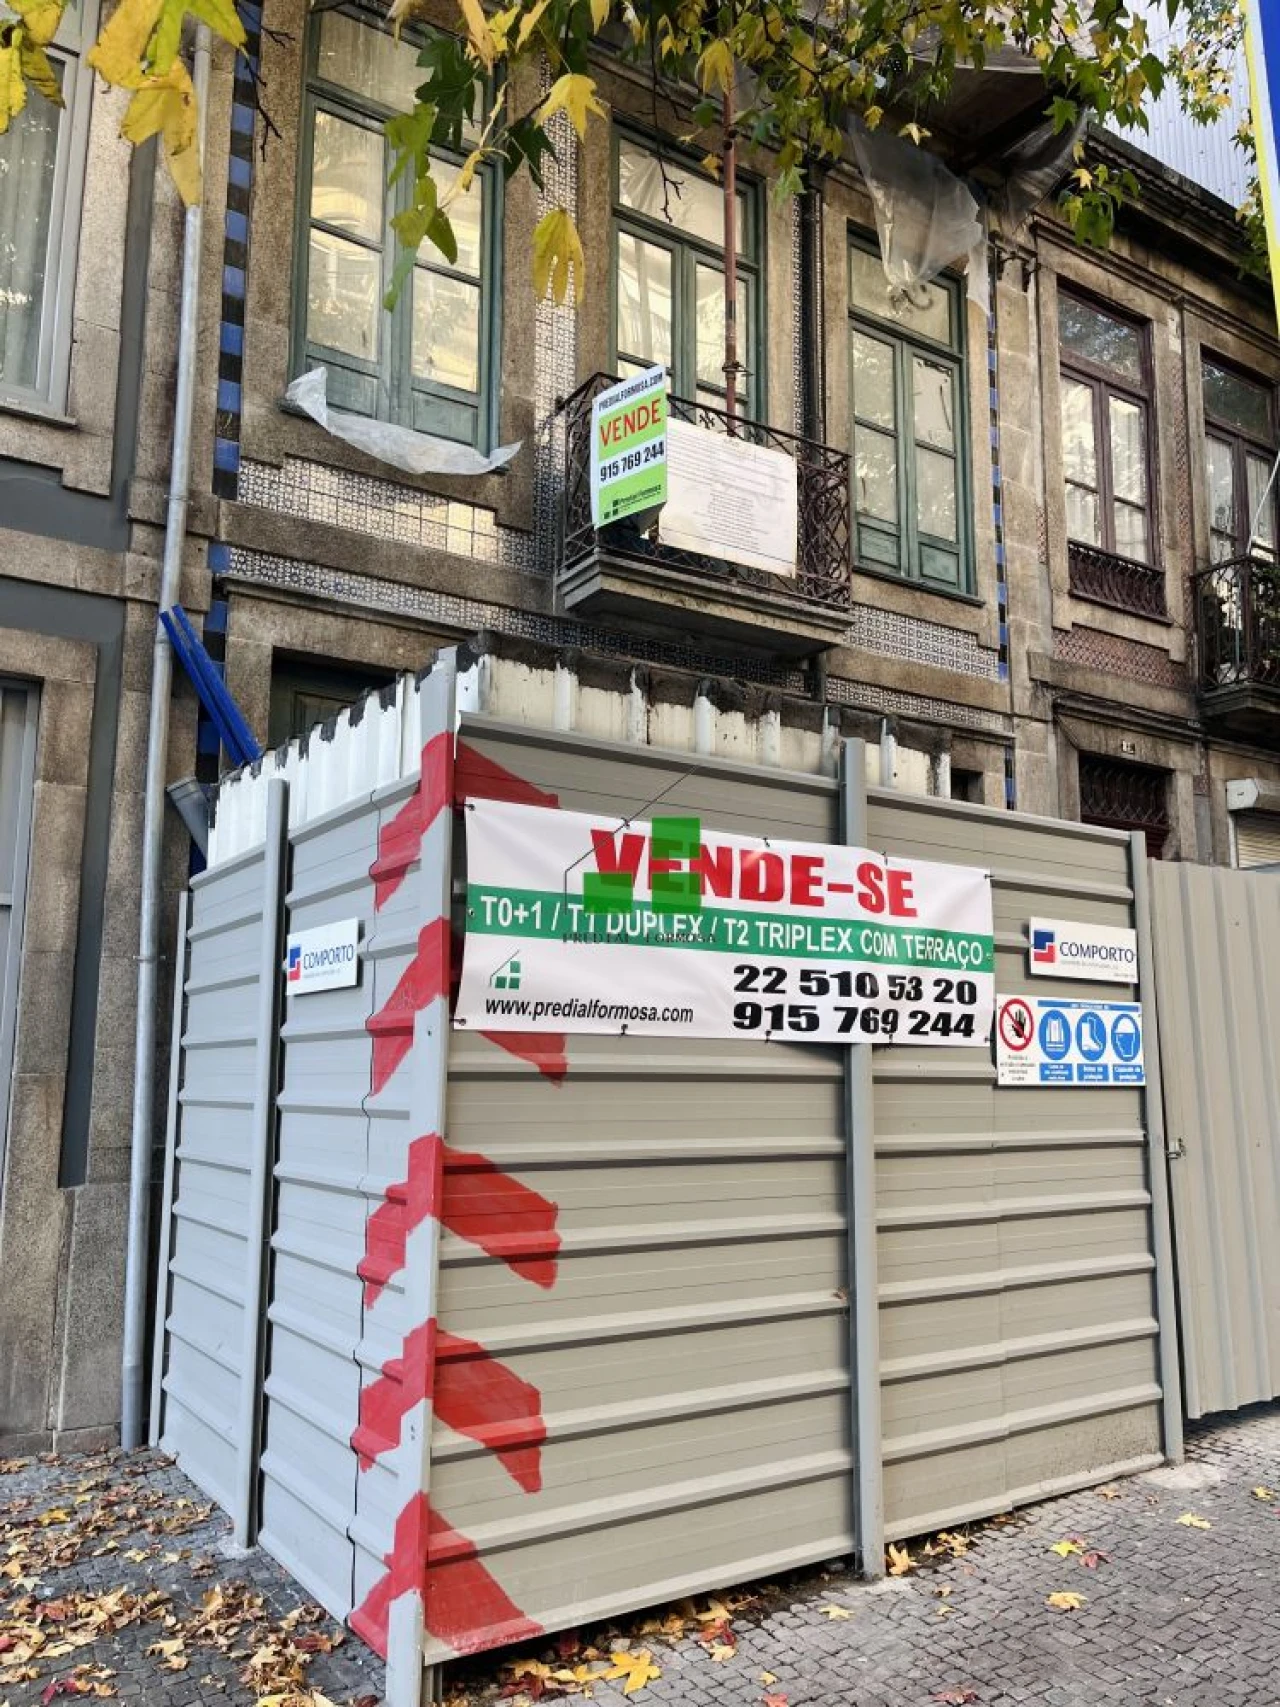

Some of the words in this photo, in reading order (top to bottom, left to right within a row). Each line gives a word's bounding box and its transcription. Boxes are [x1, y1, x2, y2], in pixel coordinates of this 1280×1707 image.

[600, 399, 662, 447] VENDE
[600, 460, 620, 482] 915
[621, 451, 641, 472] 769
[644, 441, 664, 463] 244
[590, 829, 918, 917] VENDE-SE
[480, 895, 542, 930] T0+1
[551, 903, 561, 931] /
[606, 908, 704, 940] DUPLEX
[711, 916, 718, 935] /
[724, 917, 749, 947] T2
[755, 921, 853, 953] TRIPLEX
[860, 929, 898, 957] COM
[903, 934, 983, 970] TERRAÇO
[1059, 942, 1134, 963] COMPORTO
[303, 944, 354, 970] COMPORTO
[733, 964, 788, 995] 22
[799, 969, 880, 999] 510
[887, 974, 924, 1001] 53
[933, 978, 978, 1005] 20
[485, 998, 694, 1023] www.predialformosa.com
[733, 1002, 820, 1032] 915
[833, 1006, 899, 1034] 769
[908, 1010, 976, 1038] 244
